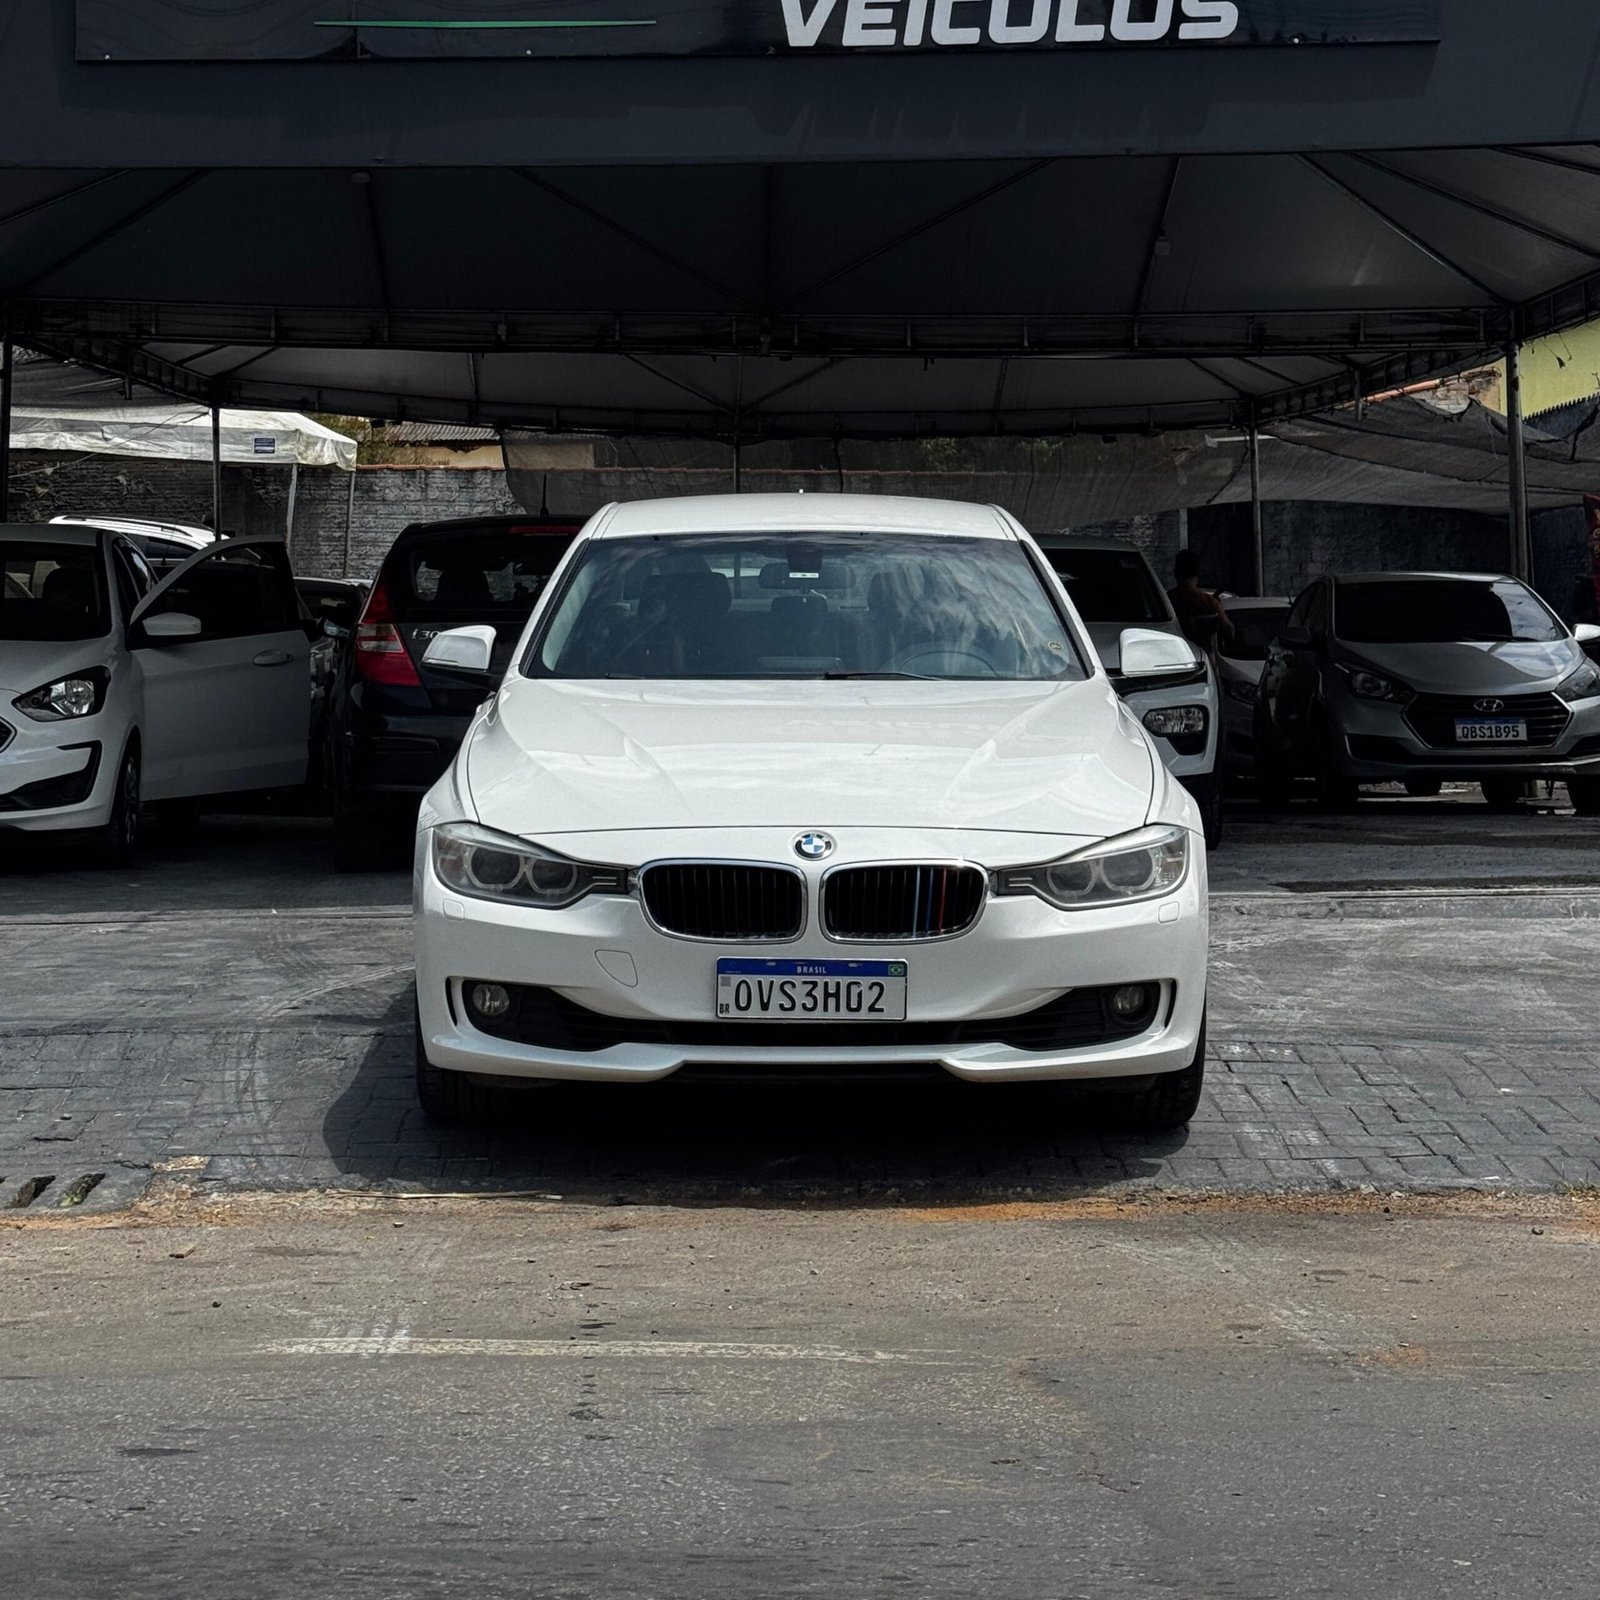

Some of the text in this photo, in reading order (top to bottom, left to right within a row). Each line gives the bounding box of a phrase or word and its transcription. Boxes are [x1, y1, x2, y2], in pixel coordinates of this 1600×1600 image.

[1461, 725, 1520, 739] QBS1B95
[796, 966, 827, 974] BRASIL
[719, 1003, 730, 1014] BR
